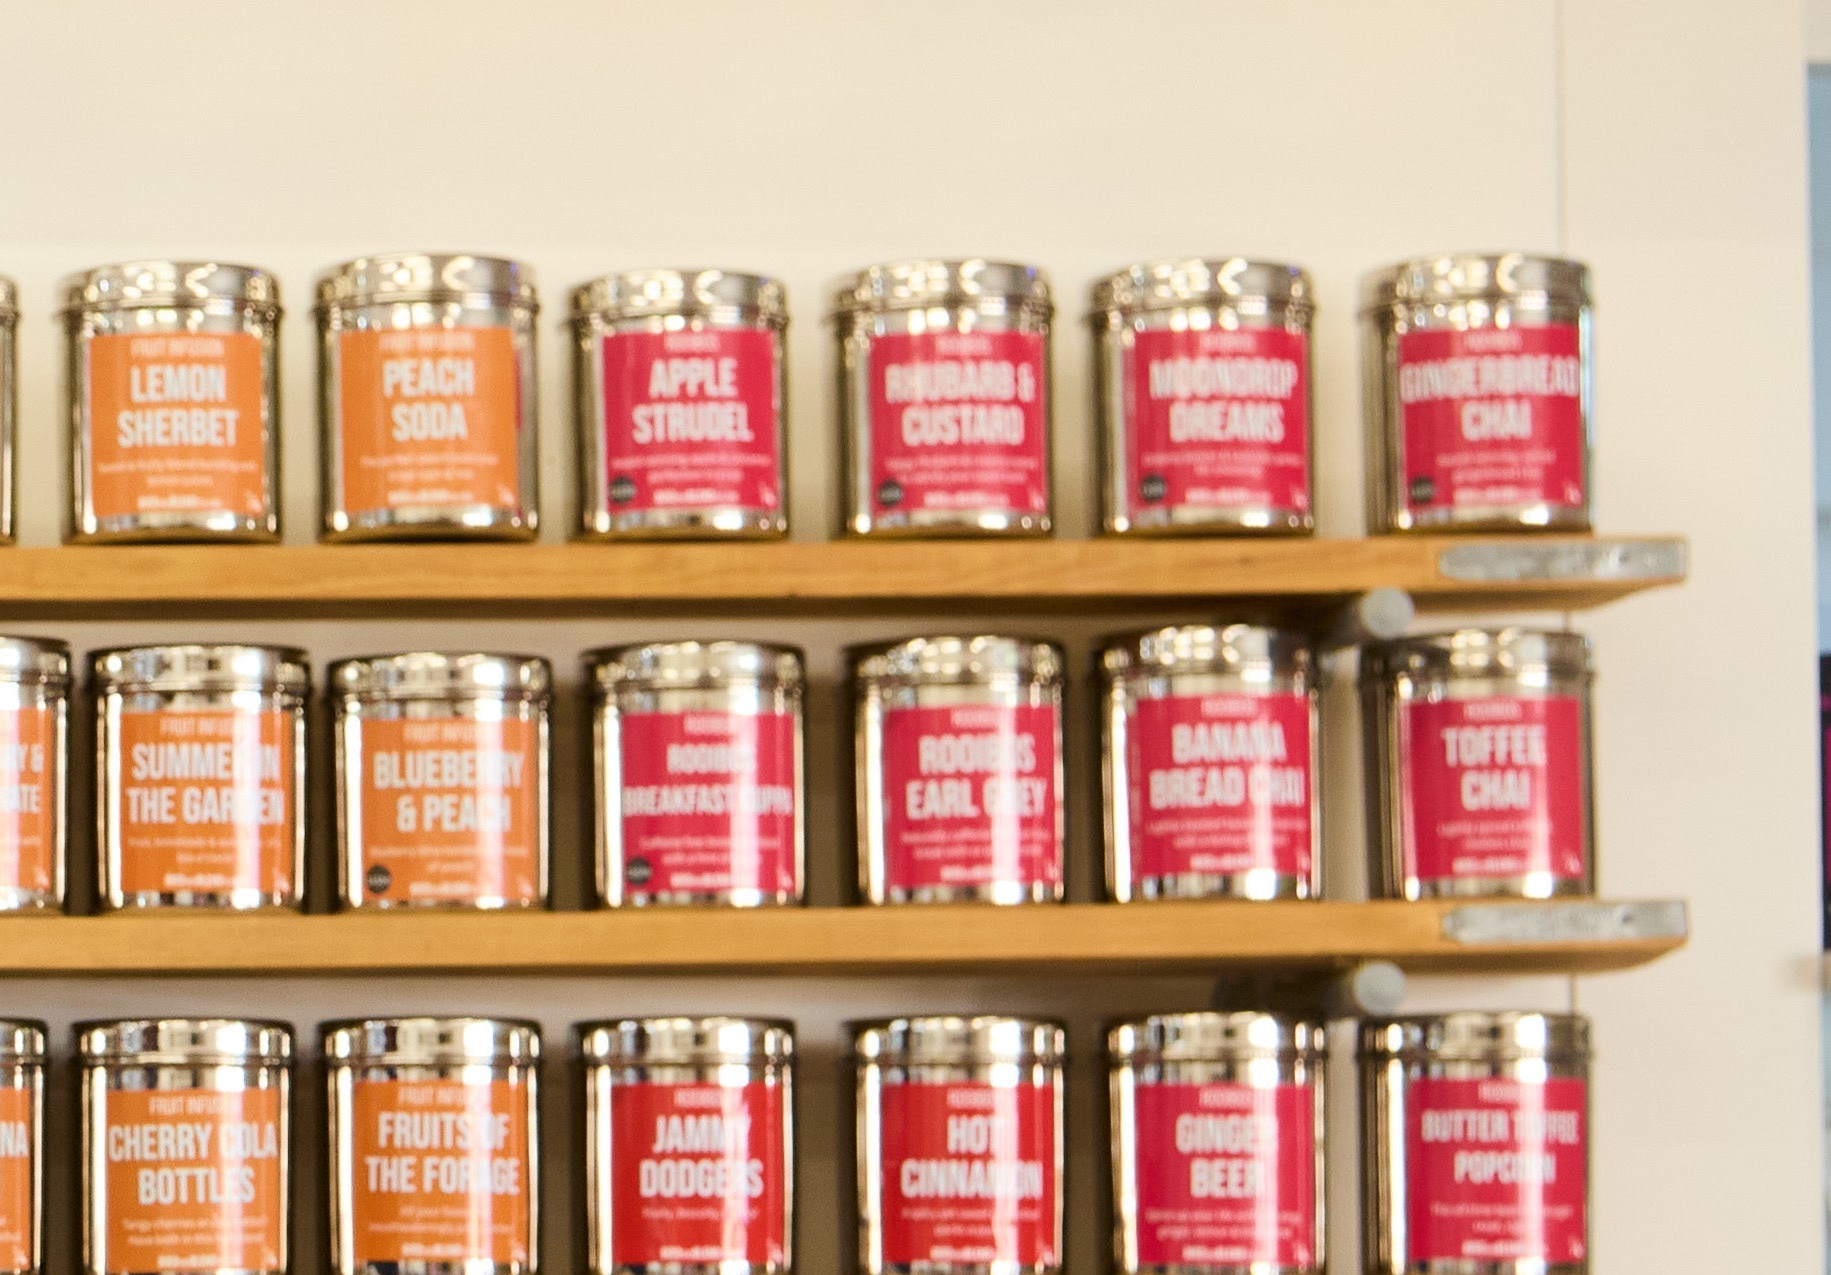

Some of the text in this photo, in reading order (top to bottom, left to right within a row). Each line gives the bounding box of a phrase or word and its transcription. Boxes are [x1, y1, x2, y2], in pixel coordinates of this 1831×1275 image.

[130, 366, 226, 403] LEMON
[383, 359, 474, 397] PEACH
[650, 359, 735, 397] APPLE
[117, 410, 239, 448] SHERBET
[392, 404, 467, 442] SODA
[633, 405, 752, 442] STRUDEL
[900, 408, 1024, 445] CUSTARD
[1462, 403, 1532, 441] CHAI
[1172, 723, 1286, 763] BANANA
[1442, 726, 1547, 767] TOFFEE
[1149, 767, 1246, 809] BREAD
[1461, 772, 1530, 811] CHAI
[109, 1124, 211, 1161] CHERRY
[138, 1165, 255, 1205] BOTTLES
